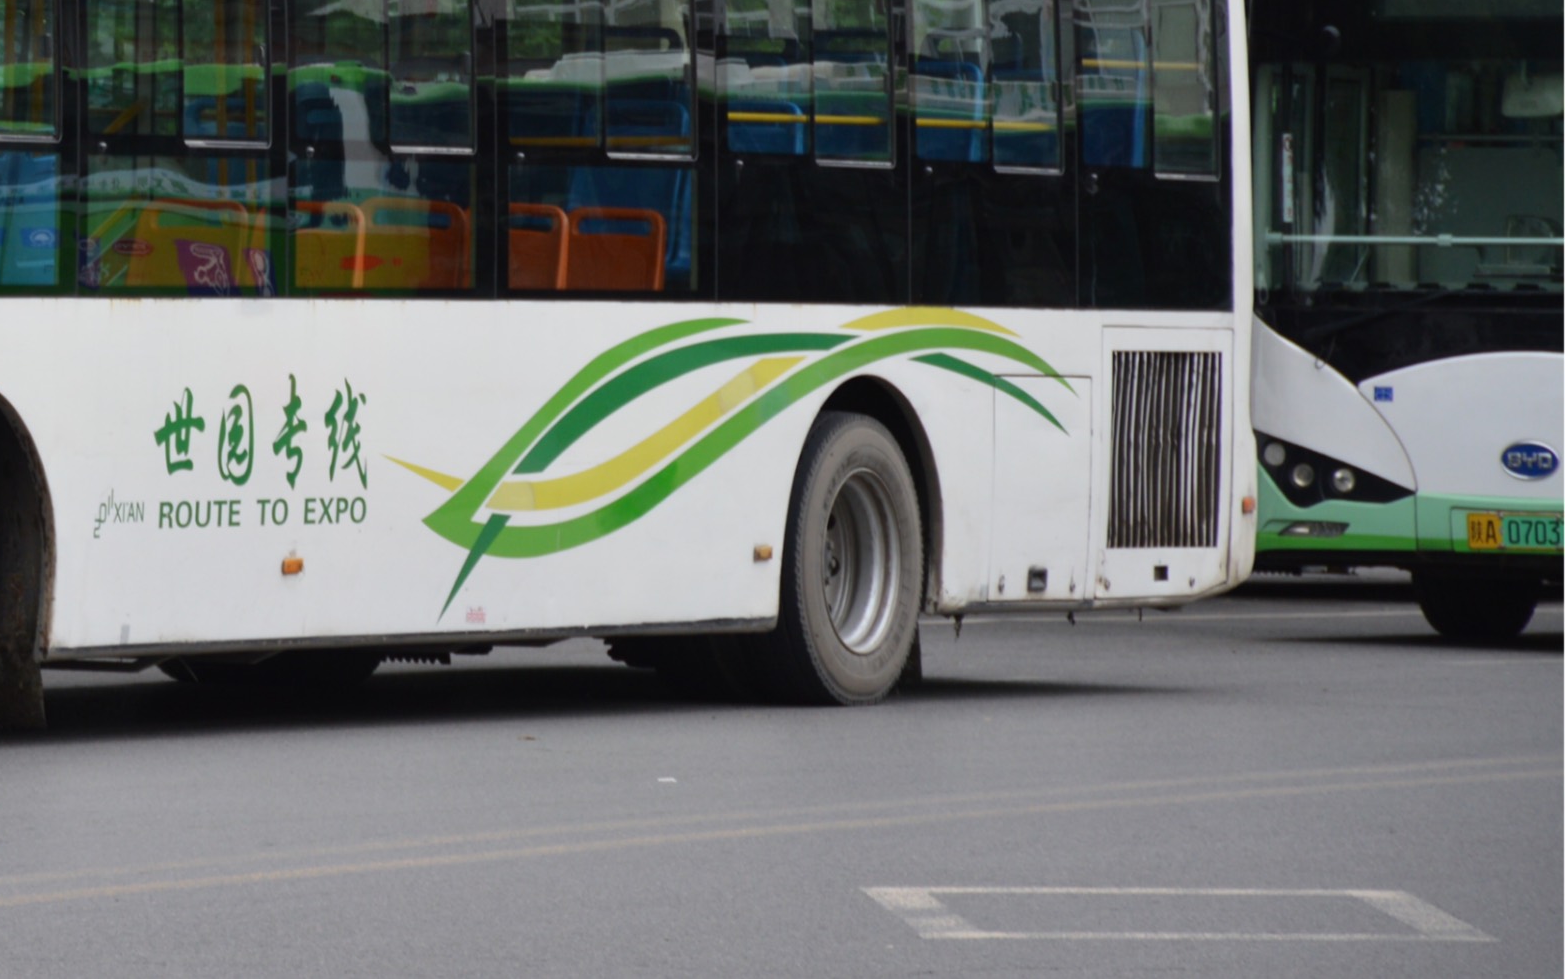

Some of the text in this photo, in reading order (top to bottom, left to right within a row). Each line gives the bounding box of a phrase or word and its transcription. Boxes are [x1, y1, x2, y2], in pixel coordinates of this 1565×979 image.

[153, 373, 368, 490] 世园专线
[1507, 451, 1553, 469] BYD
[158, 496, 367, 529] ROUTE TO EXPO
